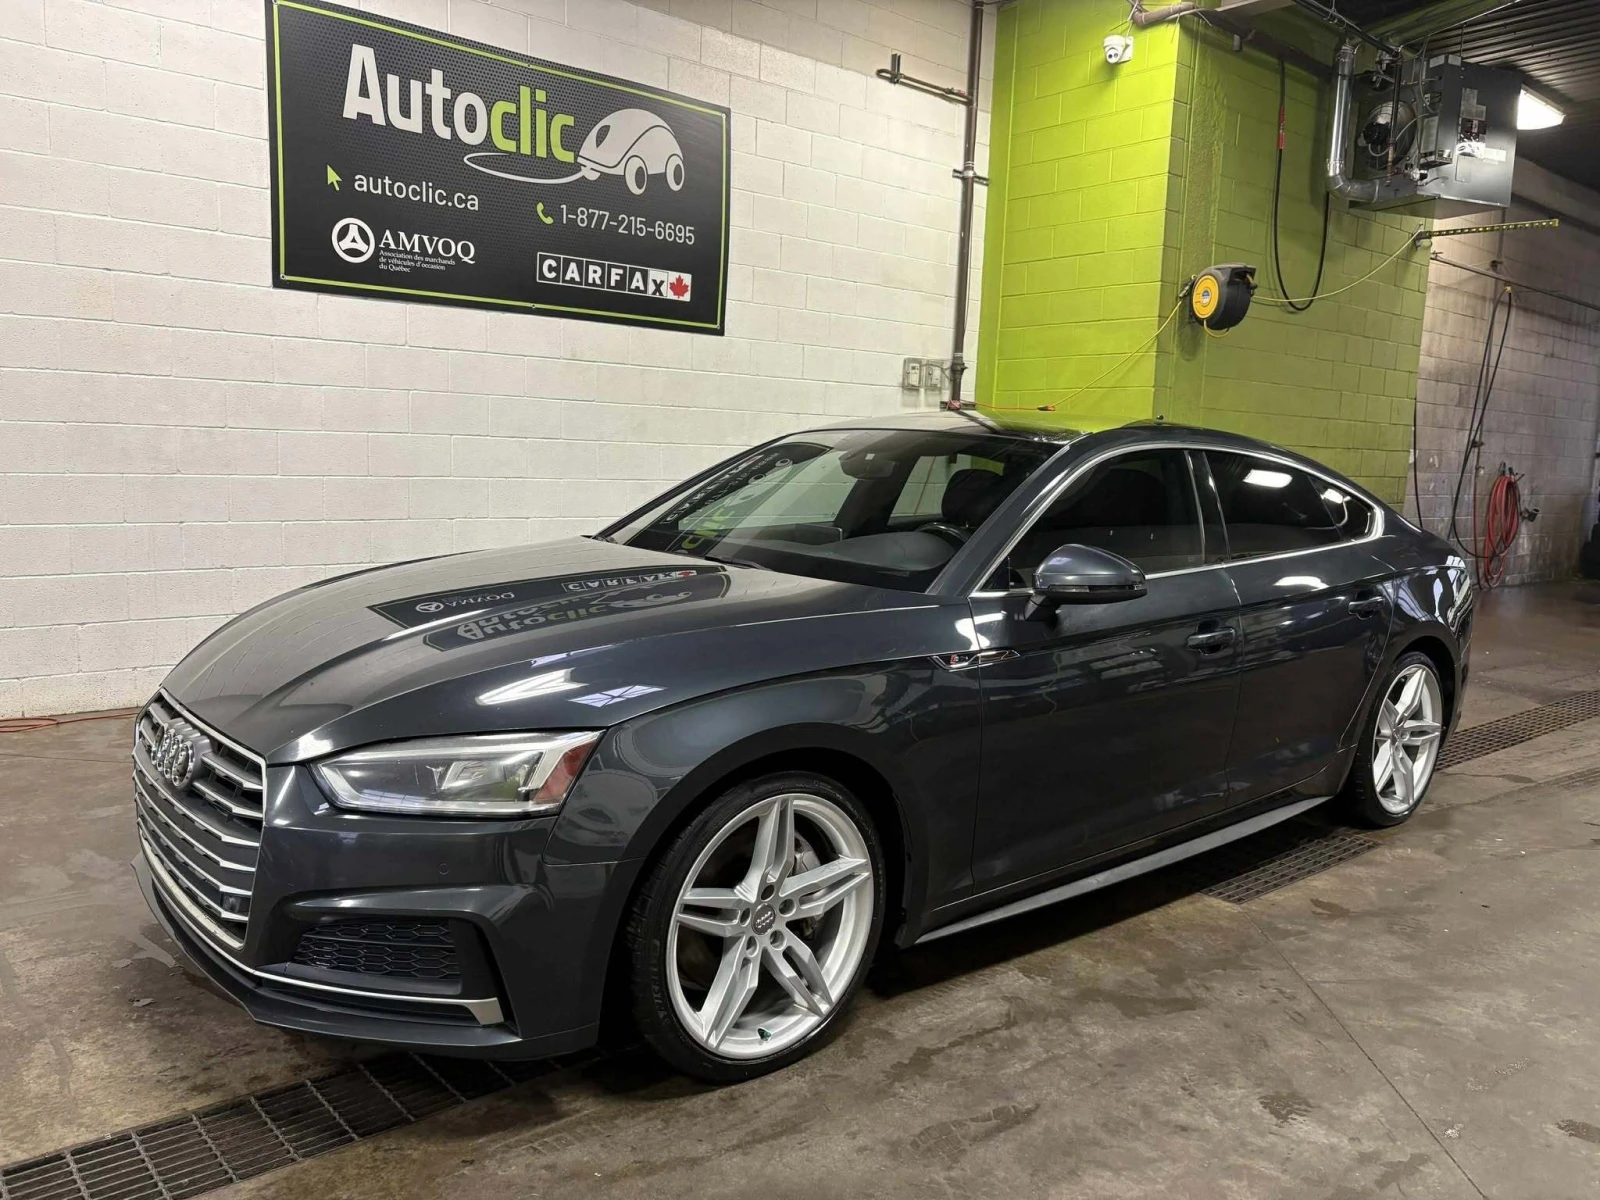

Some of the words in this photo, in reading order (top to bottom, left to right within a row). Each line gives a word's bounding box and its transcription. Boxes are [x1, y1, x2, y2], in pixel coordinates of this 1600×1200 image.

[343, 43, 575, 163] Autoclic
[354, 174, 479, 211] autoclic.ca
[561, 204, 695, 245] 1-877-215-6695
[379, 229, 476, 264] AMVOQ
[379, 250, 413, 260] Association
[413, 253, 424, 261] des
[424, 256, 456, 266] marchands
[387, 257, 415, 267] véhicules
[388, 264, 411, 273] Québec
[542, 258, 665, 297] CARFAX
